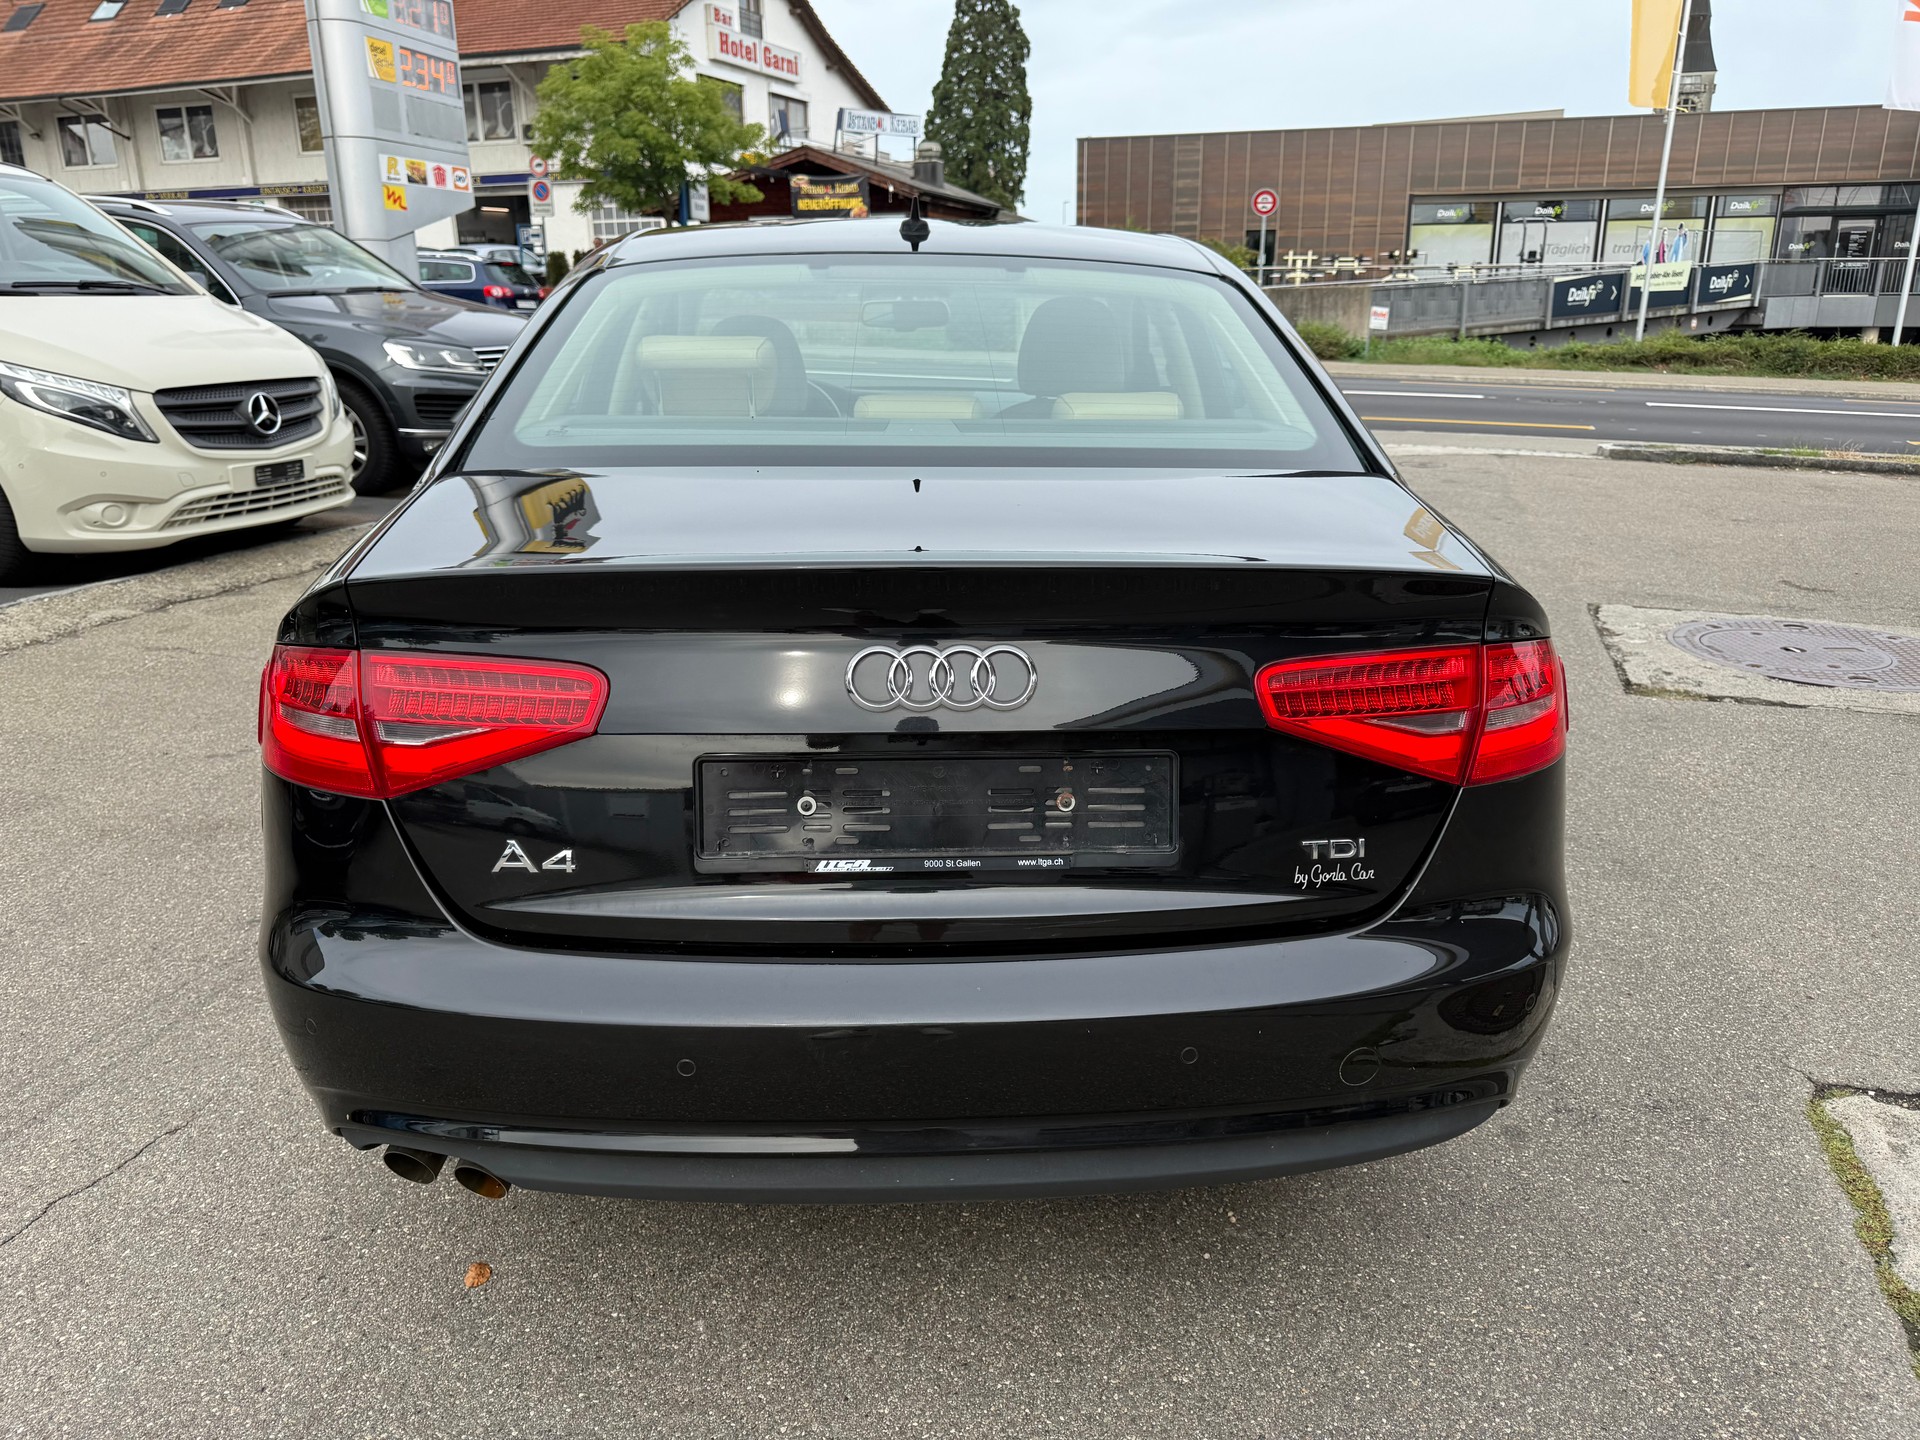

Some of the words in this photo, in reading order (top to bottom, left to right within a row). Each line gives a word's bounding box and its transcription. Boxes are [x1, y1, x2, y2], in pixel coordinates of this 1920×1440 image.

[714, 7, 733, 26] Bar
[719, 31, 758, 64] Hotel
[763, 45, 799, 76] Garni
[491, 839, 576, 873] A4
[1302, 838, 1365, 860] TDI
[924, 859, 944, 868] 9000
[956, 859, 981, 867] Gallen
[1017, 858, 1064, 867] www.ltga.ch
[1294, 865, 1308, 889] by
[1310, 864, 1347, 888] Gorla
[1350, 862, 1375, 880] Car
